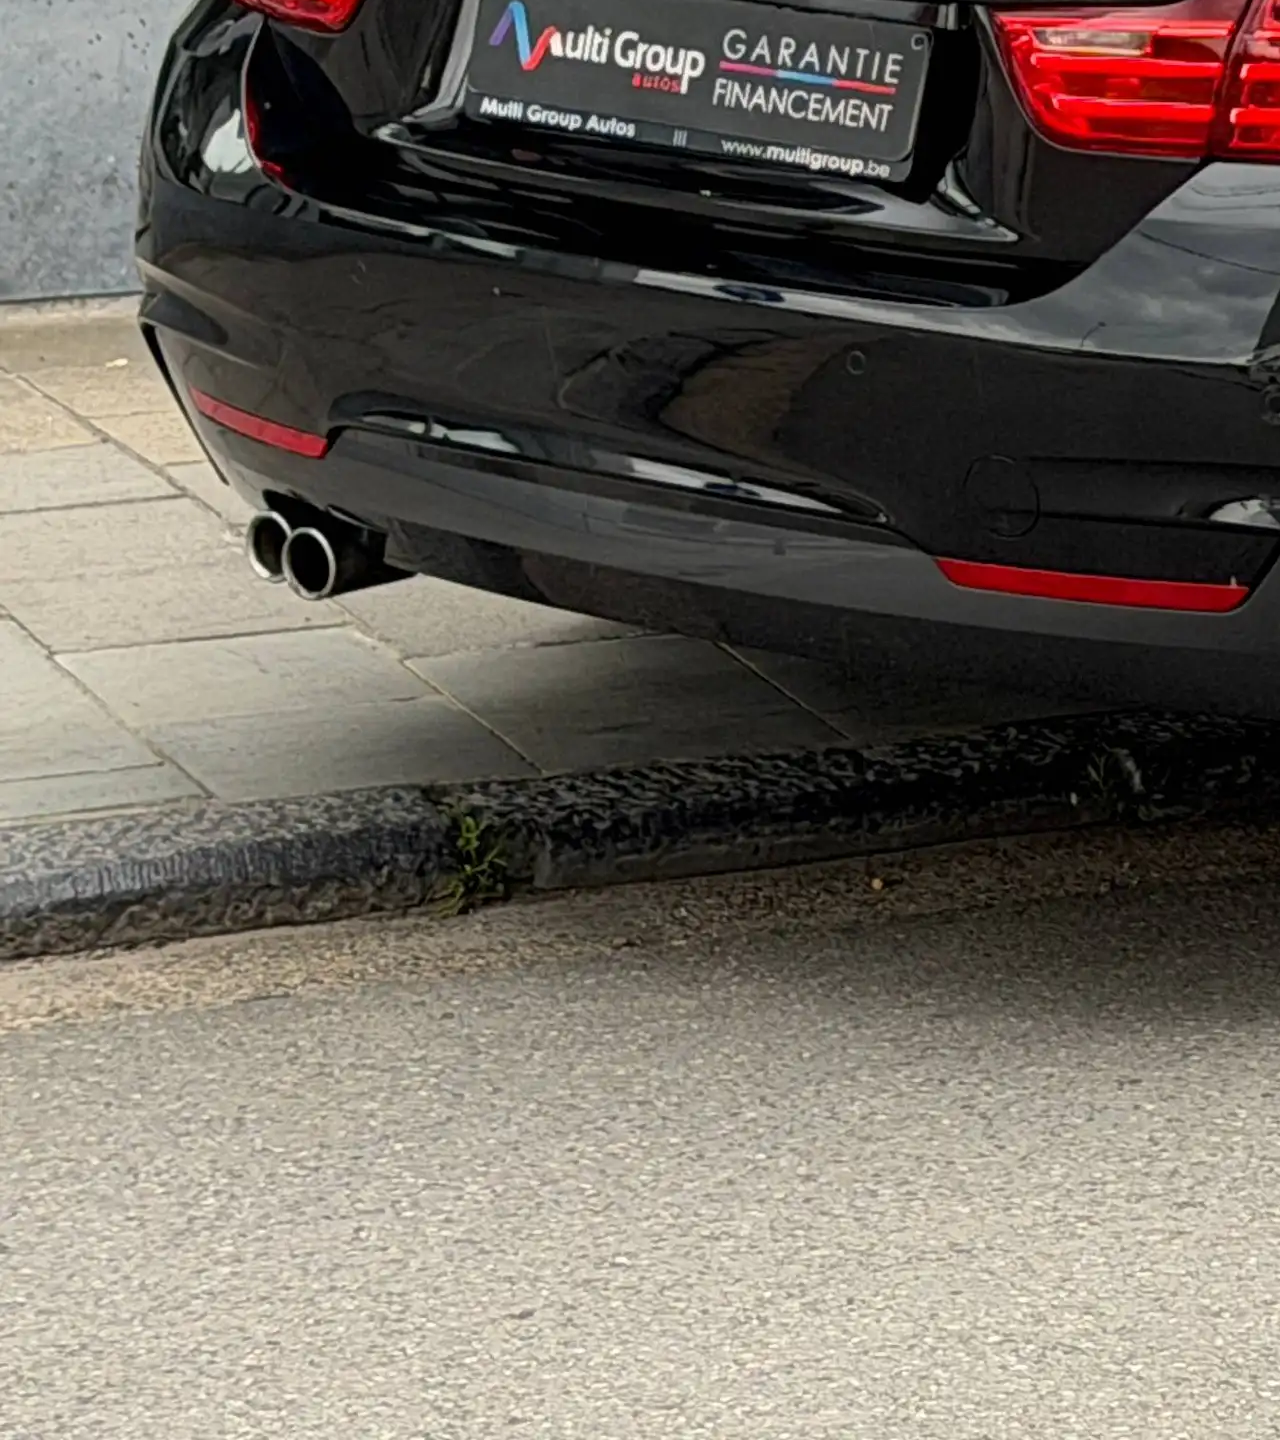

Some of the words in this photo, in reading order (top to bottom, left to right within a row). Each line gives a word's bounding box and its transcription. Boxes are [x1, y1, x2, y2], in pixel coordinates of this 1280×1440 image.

[614, 30, 705, 94] Group
[722, 28, 904, 85] GARANTIE
[632, 72, 680, 93] autos
[712, 77, 893, 133] FINANCEMENT
[480, 95, 523, 121] Multi
[526, 104, 582, 131] Group
[585, 114, 636, 138] Autos
[720, 139, 891, 179] www.multigroup.be
